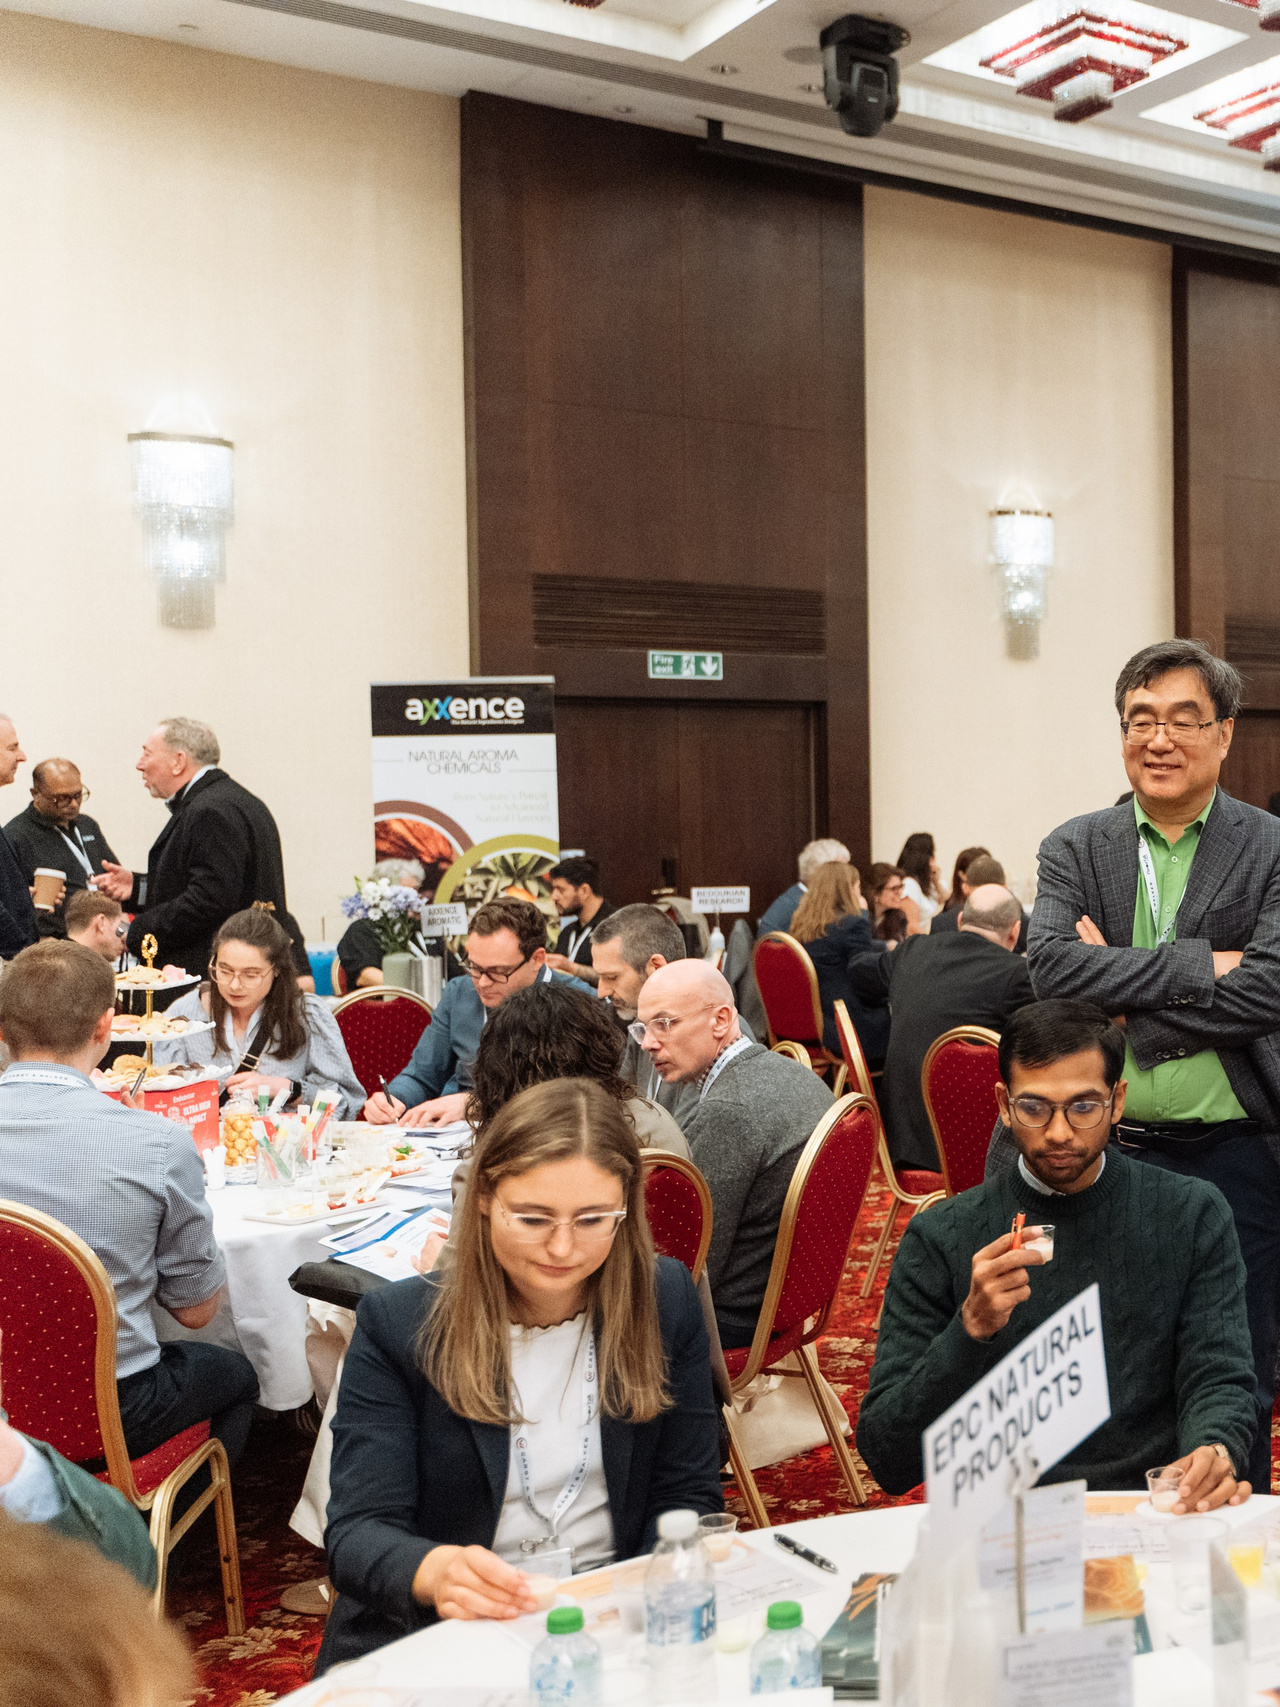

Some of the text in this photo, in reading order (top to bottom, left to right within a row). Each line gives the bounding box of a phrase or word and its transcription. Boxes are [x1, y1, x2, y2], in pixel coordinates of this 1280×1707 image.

[405, 696, 525, 726] axxence
[409, 749, 519, 762] NATURAL AROMA
[427, 761, 501, 775] CHEMICALS
[428, 906, 457, 915] AXXENCE
[427, 916, 462, 926] AROMATIC
[183, 1104, 198, 1116] ULTRA
[199, 1100, 211, 1111] HIGH
[933, 1305, 1095, 1474] EPC NATURAL
[953, 1360, 1082, 1507] PRODUCTS
